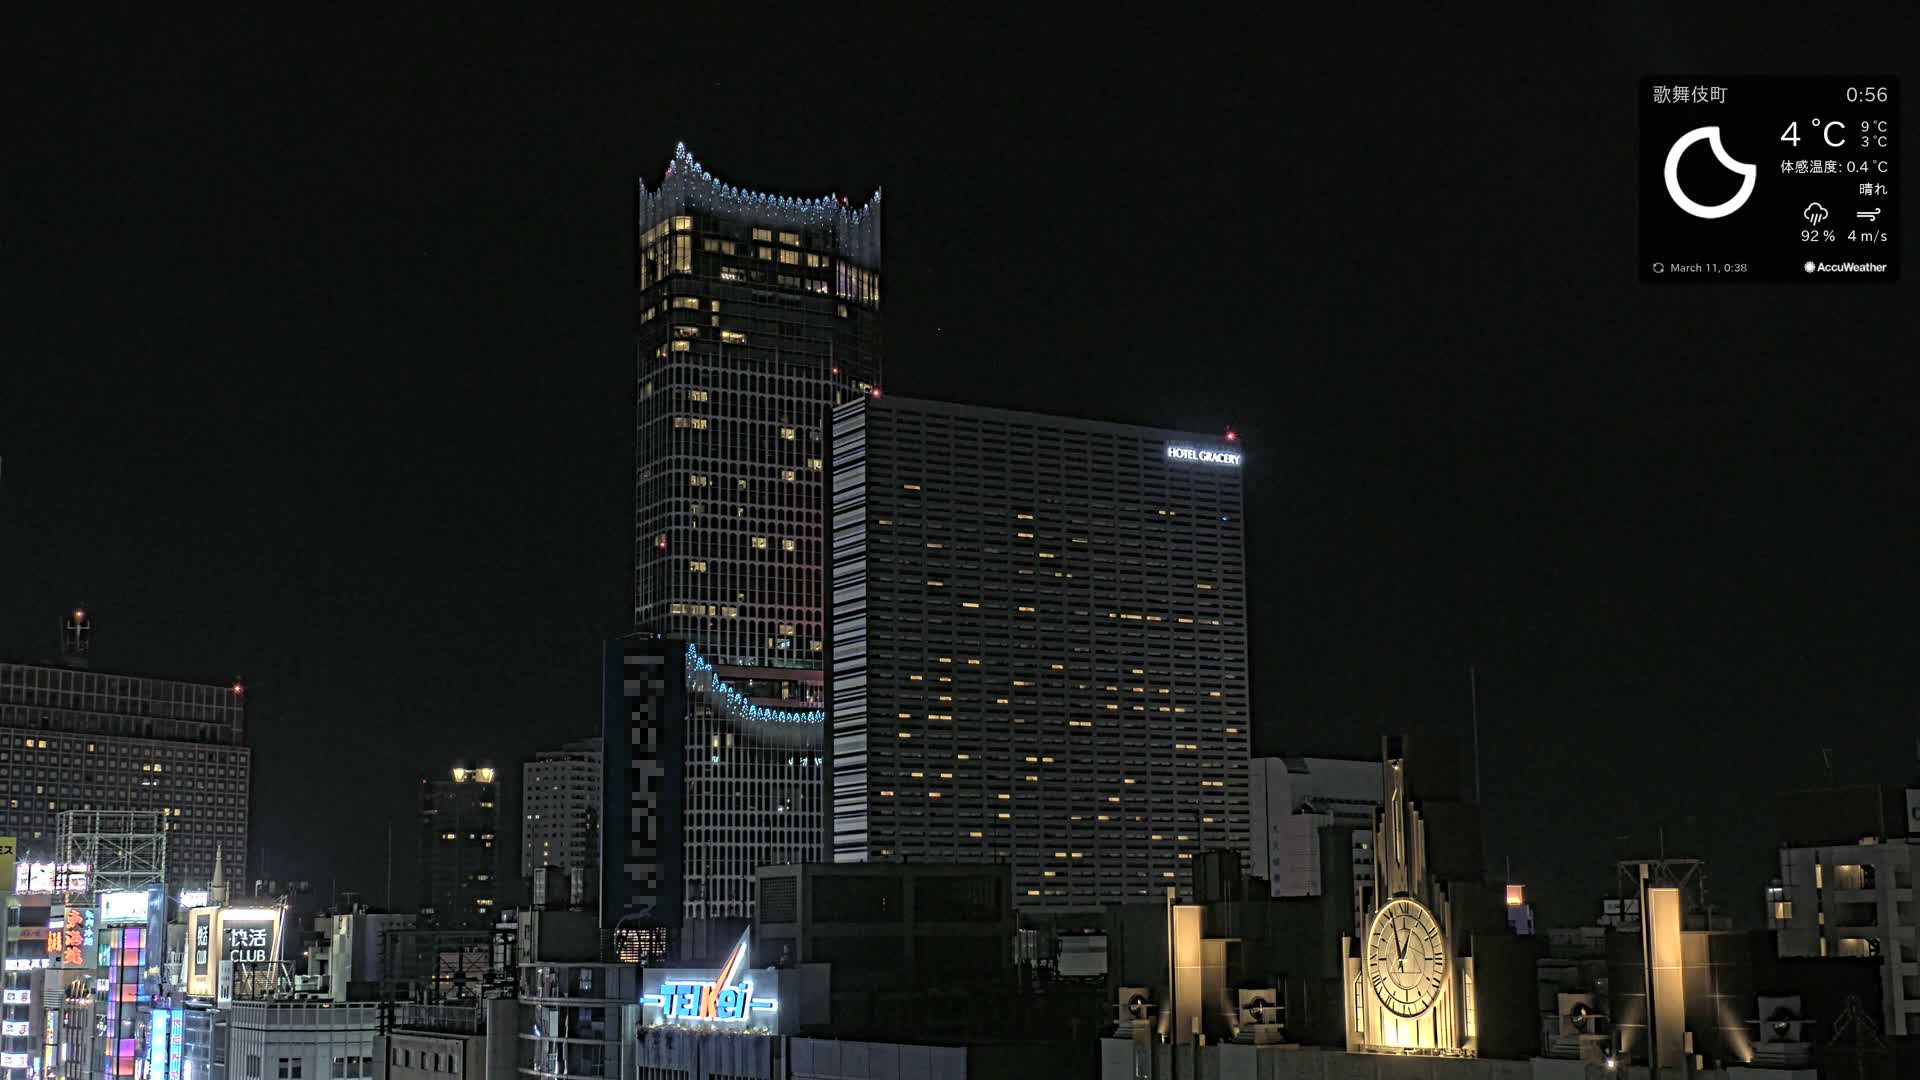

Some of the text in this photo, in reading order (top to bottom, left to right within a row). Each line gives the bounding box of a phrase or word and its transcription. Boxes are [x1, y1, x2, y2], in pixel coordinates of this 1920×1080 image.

[1168, 447, 1240, 465] HOTEL GRACERY
[230, 928, 267, 947] 快活
[230, 950, 266, 963] CLUB
